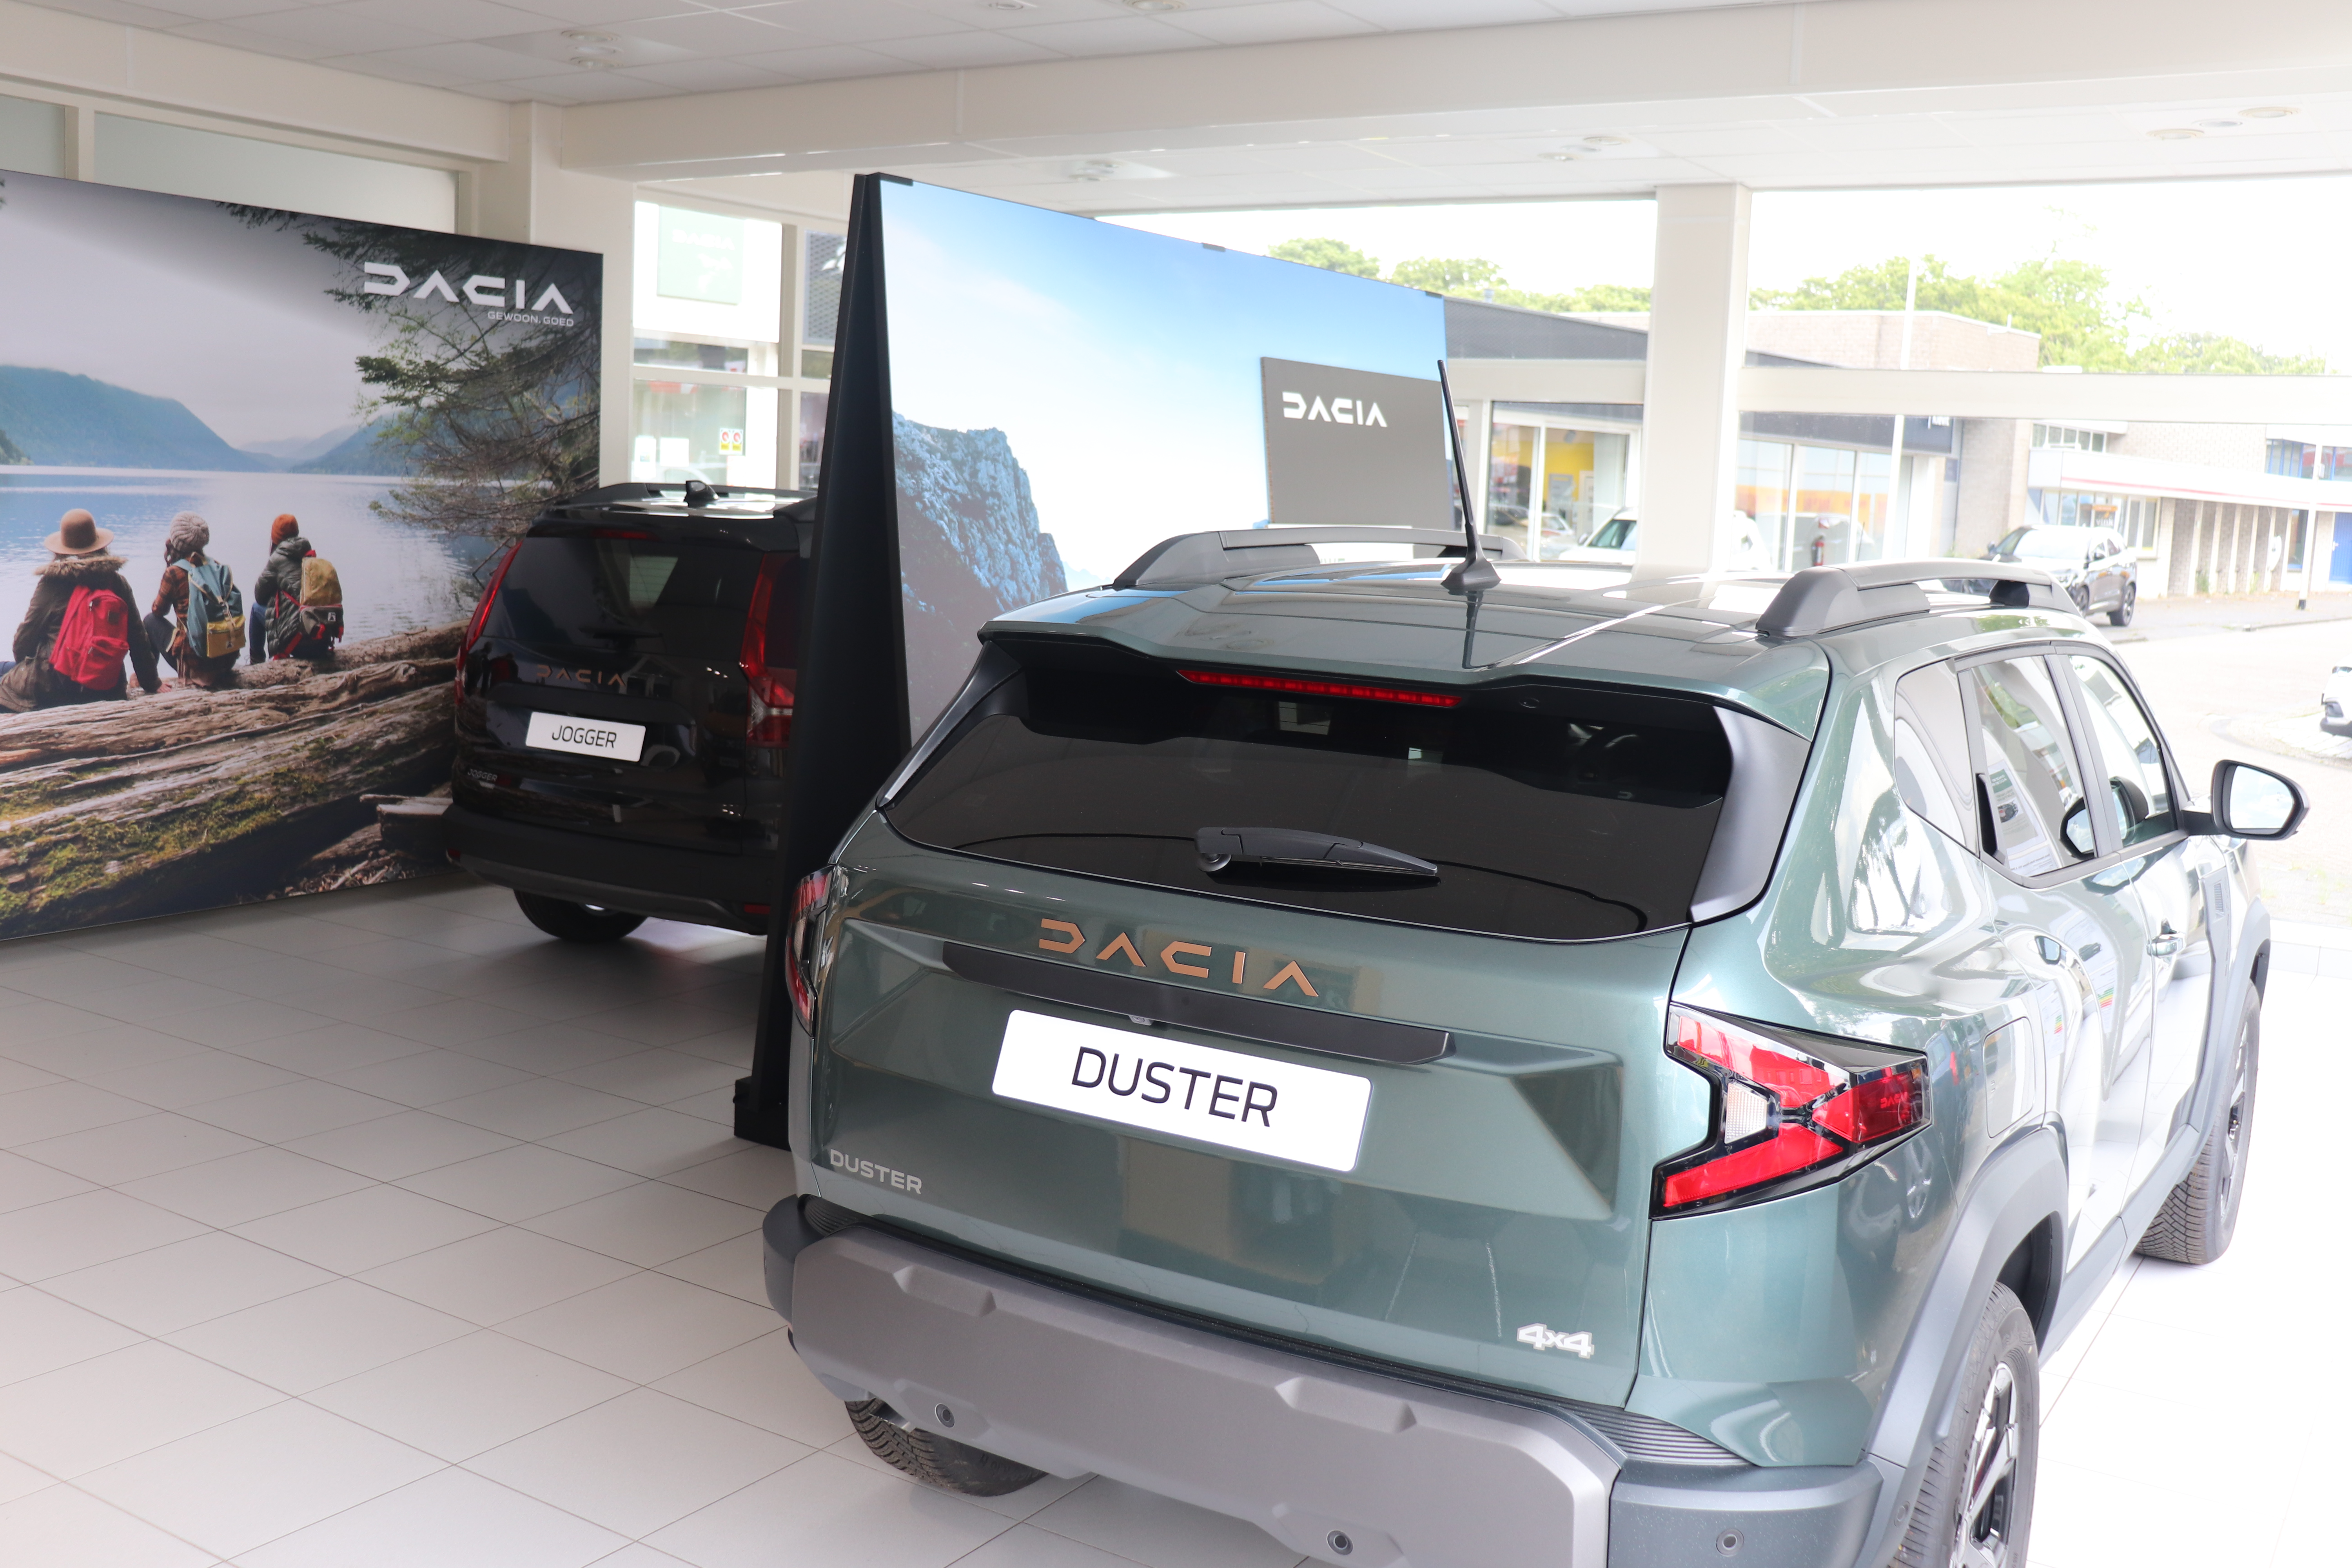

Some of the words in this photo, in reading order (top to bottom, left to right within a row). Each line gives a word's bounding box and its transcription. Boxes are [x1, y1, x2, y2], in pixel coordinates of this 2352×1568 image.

[364, 261, 573, 314] DACIA
[543, 316, 574, 327] GOED
[1282, 391, 1388, 428] DACIA
[536, 664, 626, 686] DACIA
[552, 725, 617, 748] JOGGER
[468, 768, 498, 782] JOGGER
[1039, 918, 1319, 997] DACIA
[1071, 1046, 1278, 1127] DUSTER
[830, 1149, 922, 1194] DUSTER
[1517, 1323, 1594, 1359] 4x4
